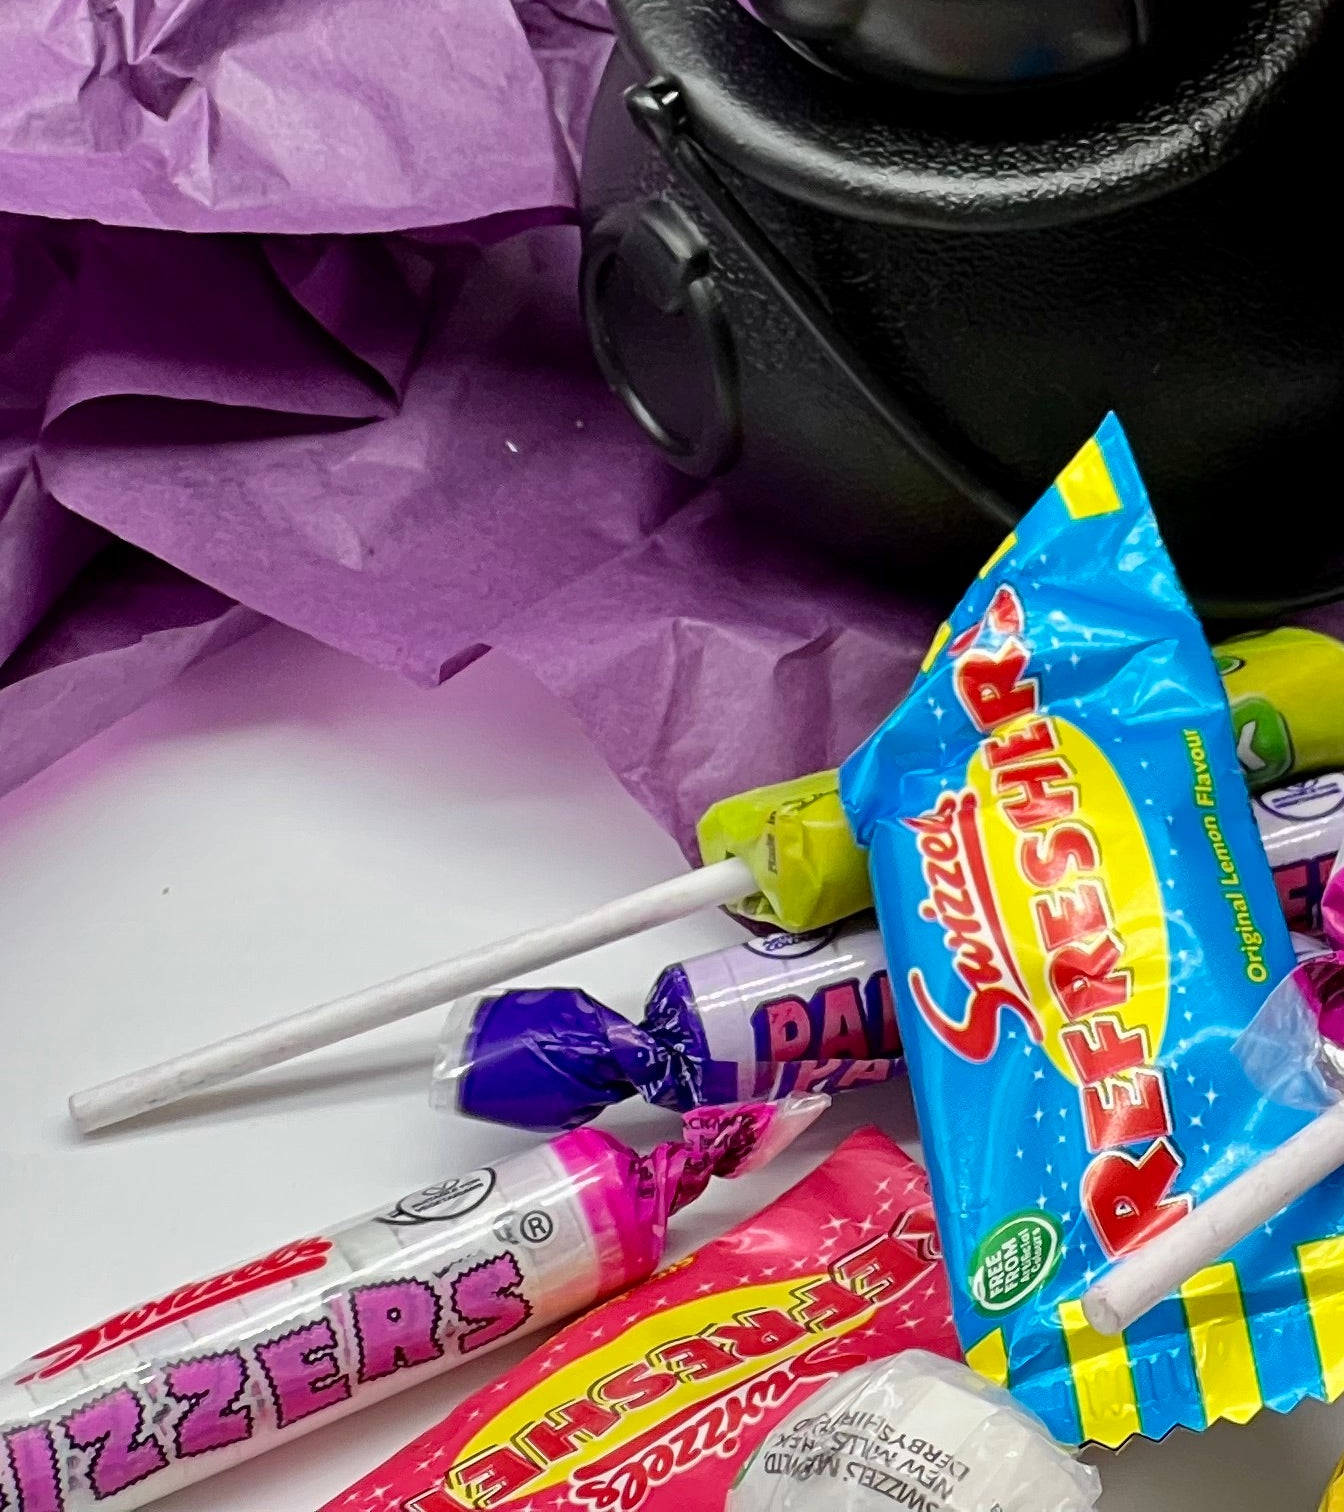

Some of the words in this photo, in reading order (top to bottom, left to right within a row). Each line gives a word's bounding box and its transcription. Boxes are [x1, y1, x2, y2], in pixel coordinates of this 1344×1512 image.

[1183, 729, 1217, 808] Flavour
[1203, 813, 1247, 887] Lemon
[1229, 892, 1267, 984] Original
[985, 1250, 1005, 1299] FREE
[1001, 1238, 1020, 1294] FROM
[0, 1251, 534, 1512] IZZERS
[403, 1206, 945, 1512] EFRESHE
[840, 1409, 972, 1481] DERBYSHIR
[897, 1458, 955, 1500] NEW
